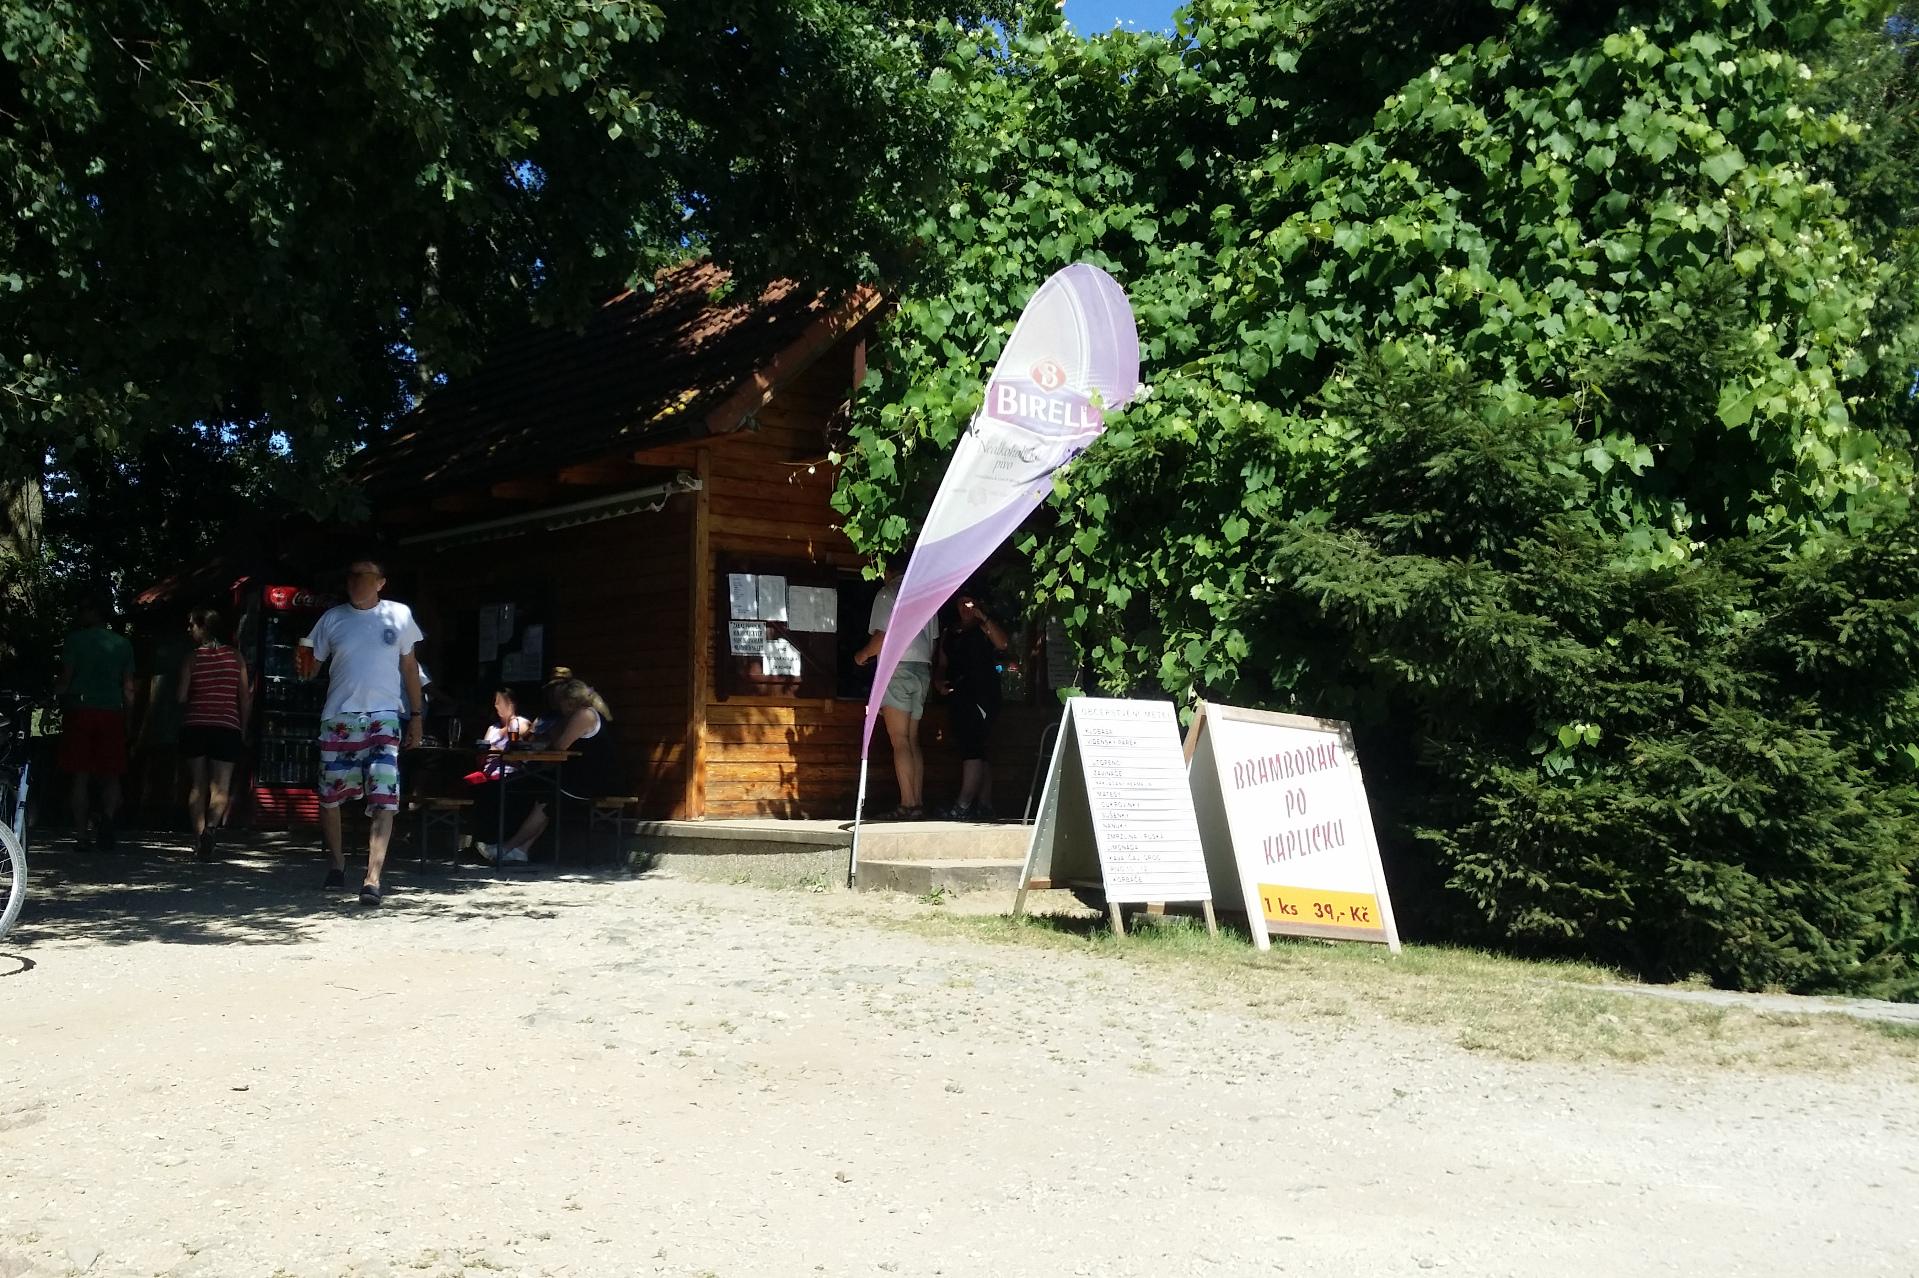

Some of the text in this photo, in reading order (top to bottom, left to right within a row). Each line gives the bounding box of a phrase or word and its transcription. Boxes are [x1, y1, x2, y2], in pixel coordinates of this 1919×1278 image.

[997, 384, 1098, 428] BIRELL
[992, 458, 1014, 474] pivo
[1234, 740, 1339, 790] BRAMBORÁK
[1285, 788, 1307, 818] PO
[1264, 897, 1272, 913] 1
[1278, 898, 1299, 916] ks
[1350, 905, 1370, 923] Kč
